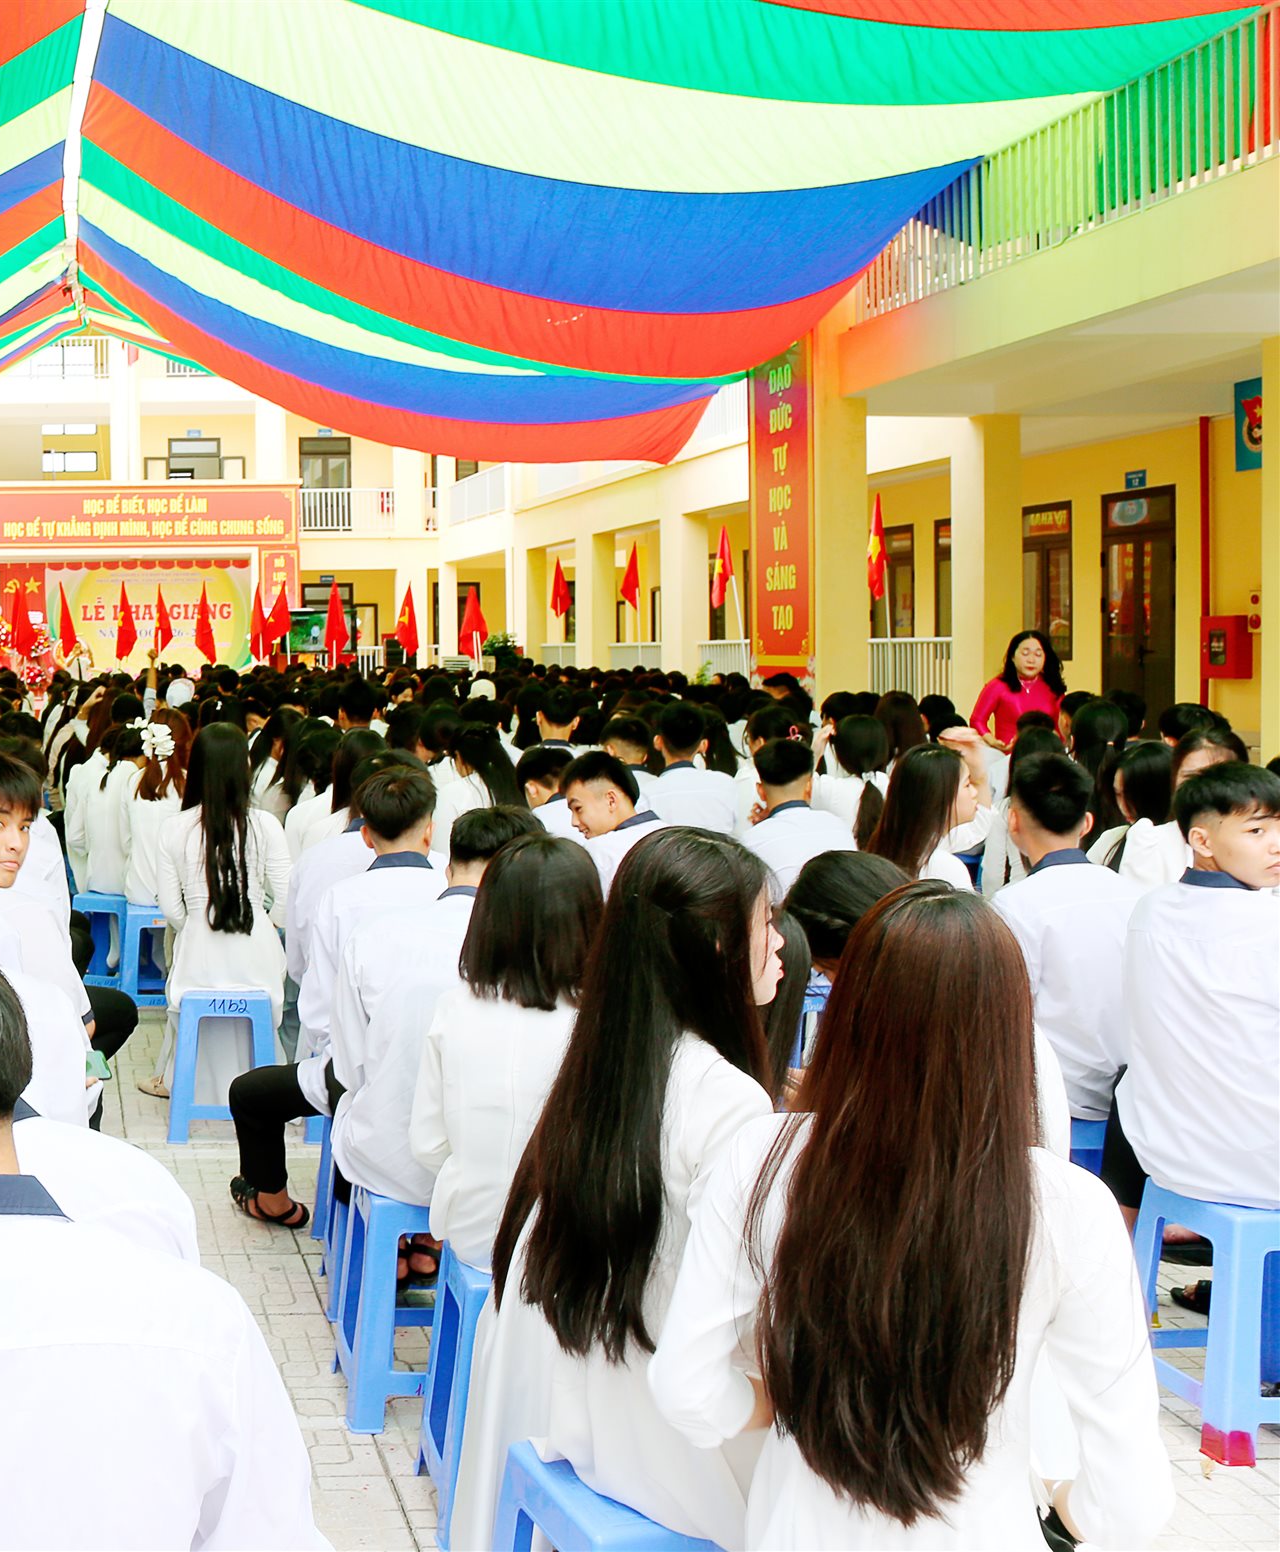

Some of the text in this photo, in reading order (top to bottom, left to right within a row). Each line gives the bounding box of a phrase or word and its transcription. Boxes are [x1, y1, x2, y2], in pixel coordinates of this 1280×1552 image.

[768, 363, 792, 397] ĐẠO
[769, 400, 792, 434] ĐỨC
[772, 442, 788, 476] TỰ
[83, 498, 105, 517] HỌC
[147, 497, 168, 516] HỌC
[185, 495, 208, 513] LÀM
[769, 485, 791, 517] HỌC
[4, 522, 25, 540] HỌC
[42, 520, 56, 540] TỰ
[93, 522, 118, 539] ĐỊNH
[151, 520, 172, 538] HỌC
[219, 520, 254, 535] CHUNG
[256, 514, 284, 534] SỐNG
[773, 522, 788, 551] VÀ
[765, 560, 796, 592] SÁNG
[81, 597, 105, 621] LỄ
[772, 604, 793, 635] TẠO
